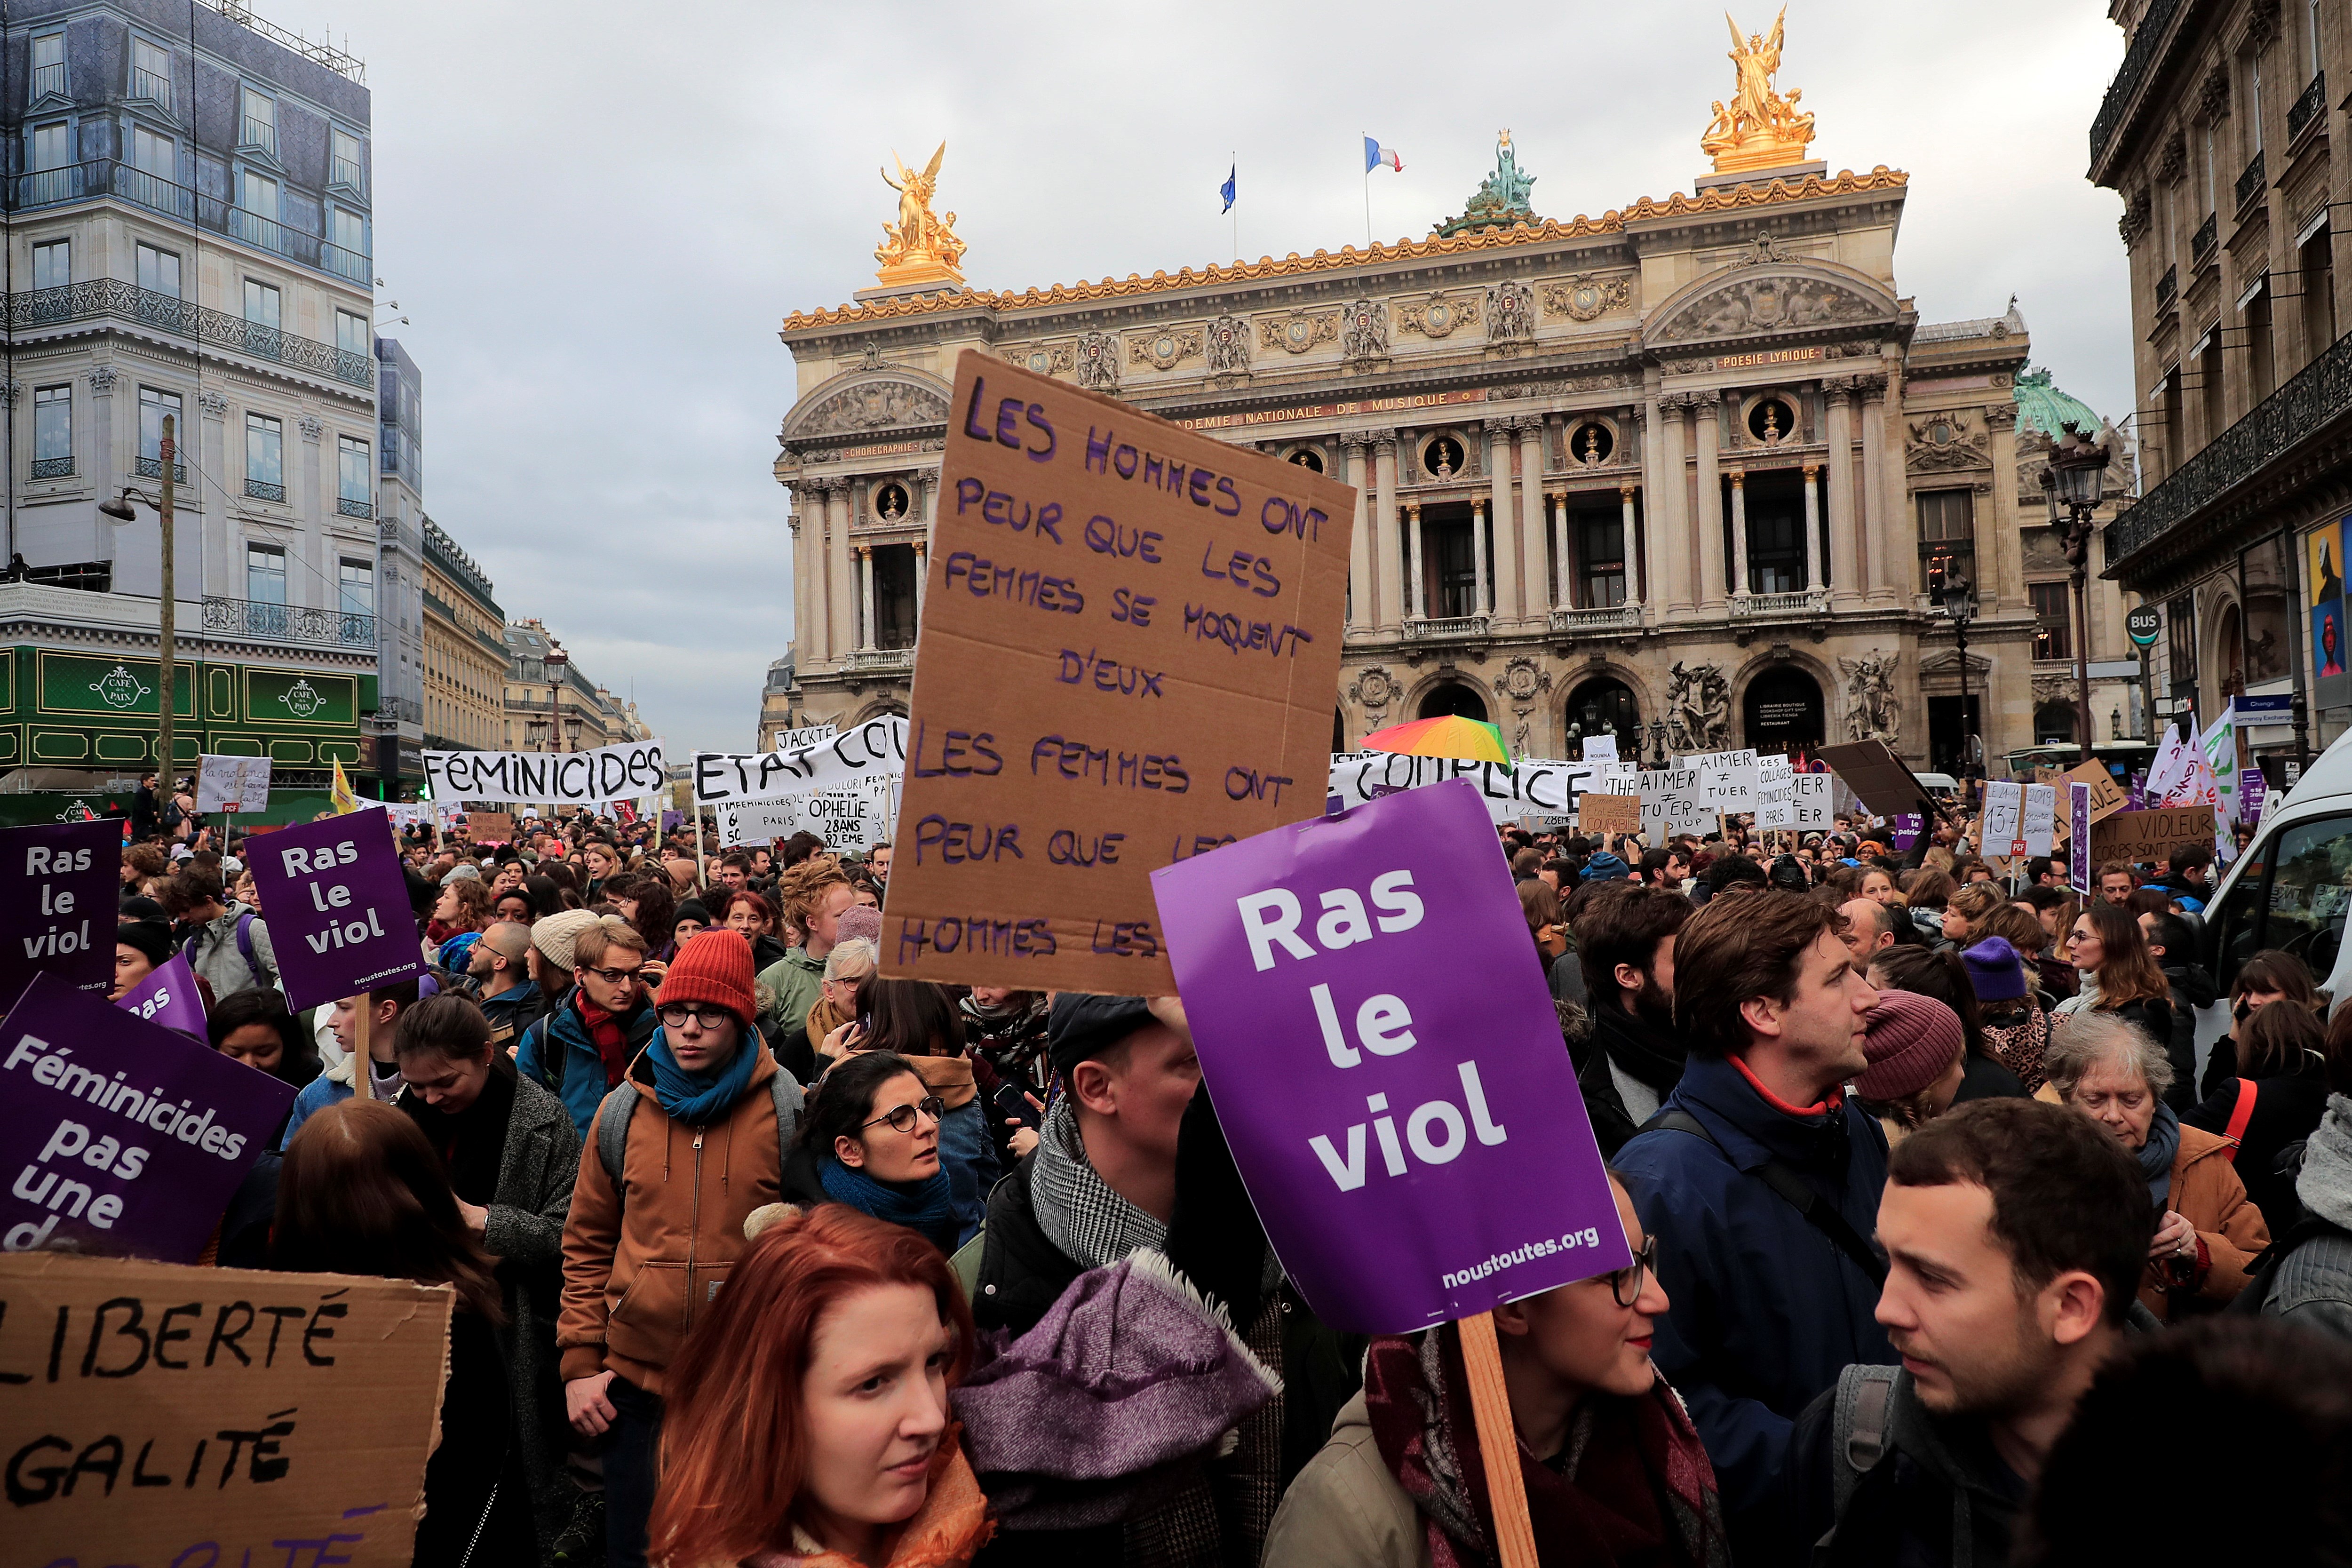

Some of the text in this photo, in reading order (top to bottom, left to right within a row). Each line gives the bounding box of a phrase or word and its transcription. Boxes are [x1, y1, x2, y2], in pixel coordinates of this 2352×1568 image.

[1724, 348, 1814, 368] POESIE LYRIQUE
[1246, 406, 1322, 423] NATIONALE
[1336, 402, 1357, 415] DE
[1372, 393, 1447, 411] MUSIQUE
[850, 442, 912, 457] CHOREGRAPHIE
[963, 376, 1329, 543] LES HOMMES ONT
[956, 477, 1281, 598] PEUR QUE LES
[945, 551, 1315, 658] FEMMES SE MOQUENT
[2131, 614, 2157, 628] BUS
[109, 678, 131, 688] CAFÉ
[1054, 646, 1166, 699] D'EUX
[110, 692, 131, 701] PAIX
[293, 691, 311, 700] CAFÉ
[206, 758, 269, 779] la violence
[697, 746, 816, 800] ETAT
[913, 719, 1004, 780] LES
[1031, 733, 1191, 794] FEMMES
[1224, 765, 1294, 807] ONT
[1700, 751, 1753, 770] AIMER
[1760, 766, 1792, 783] COLLAGES
[223, 780, 239, 790] est
[1640, 770, 1696, 791] AIMER
[1707, 786, 1748, 798] TUER
[1757, 786, 1793, 805] FEMINICIDES
[1987, 785, 1997, 798] LE
[2028, 788, 2052, 806] 2019
[736, 798, 792, 808] FEMINICIDES
[1765, 808, 1785, 825] PARIS
[763, 815, 794, 826] PARIS
[1985, 805, 2018, 834] 137
[2137, 813, 2214, 840] VIOLEUR
[915, 813, 1026, 866] PEUR
[1047, 829, 1128, 868] QUE
[2012, 843, 2025, 852] PCF
[2093, 843, 2132, 862] CORPS
[2135, 842, 2167, 858] SONT
[26, 846, 91, 876] Ras
[281, 841, 358, 878] Ras
[41, 884, 74, 915] le
[309, 881, 352, 912] le
[305, 907, 385, 954] viol
[1236, 868, 1425, 972] Ras
[23, 919, 90, 959] viol
[897, 915, 1159, 965] HOMMES LES
[354, 962, 417, 986] noustoutes.org
[1309, 982, 1418, 1069] le
[2, 1035, 247, 1161] Féminicides
[1308, 1059, 1508, 1193] viol
[37, 1118, 151, 1181] pas
[11, 1164, 124, 1230] une
[1441, 1226, 1600, 1290] noustoutes.org
[0, 1288, 350, 1384] LIBERTÉ
